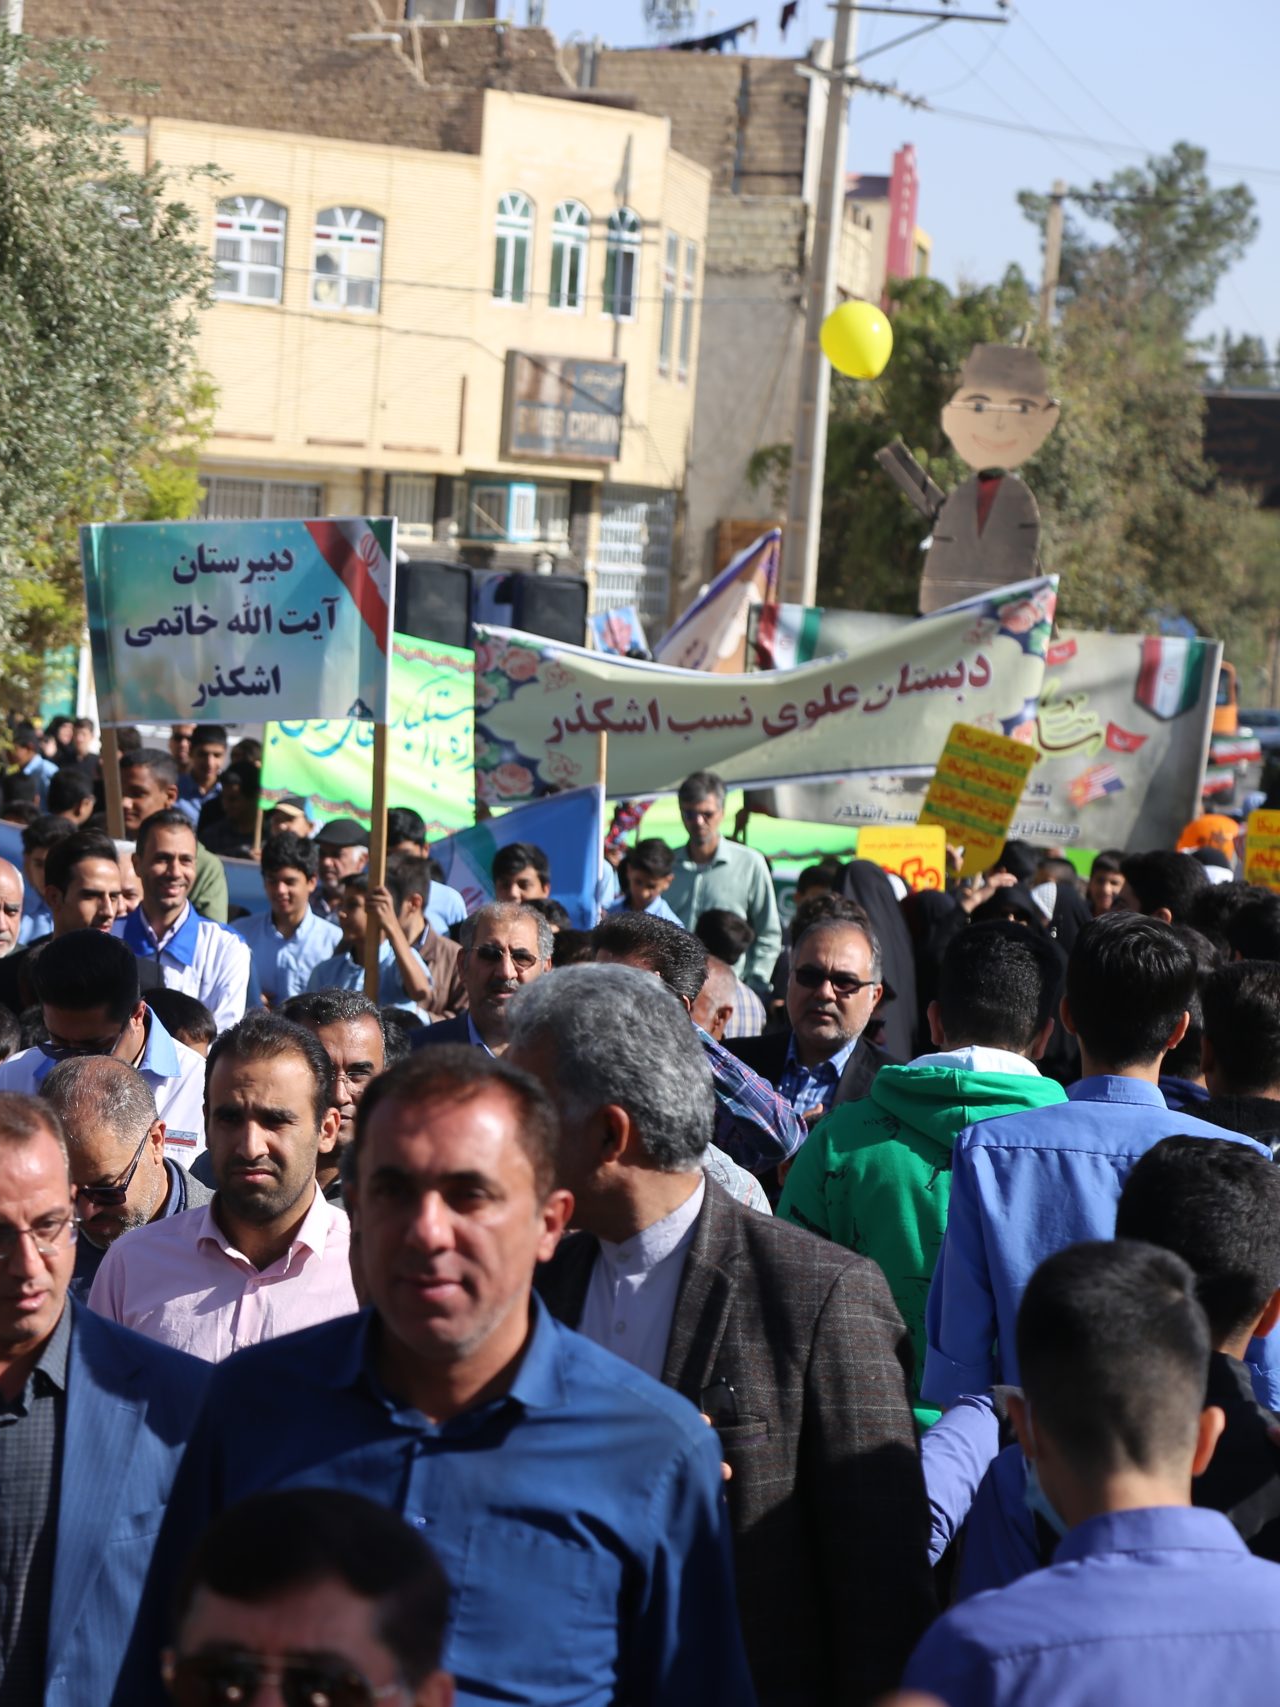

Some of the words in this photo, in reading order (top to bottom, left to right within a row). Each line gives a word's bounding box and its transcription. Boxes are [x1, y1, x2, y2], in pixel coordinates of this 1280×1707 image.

[172, 543, 294, 584] دبیرستان
[124, 602, 218, 647] خاتمی
[226, 596, 272, 635] الله
[278, 596, 341, 640] آیت
[191, 664, 282, 707] اشکذر
[862, 653, 993, 713] دبستان
[545, 692, 661, 744] اشکذر
[666, 695, 754, 742] نسب
[762, 682, 860, 737] علوی
